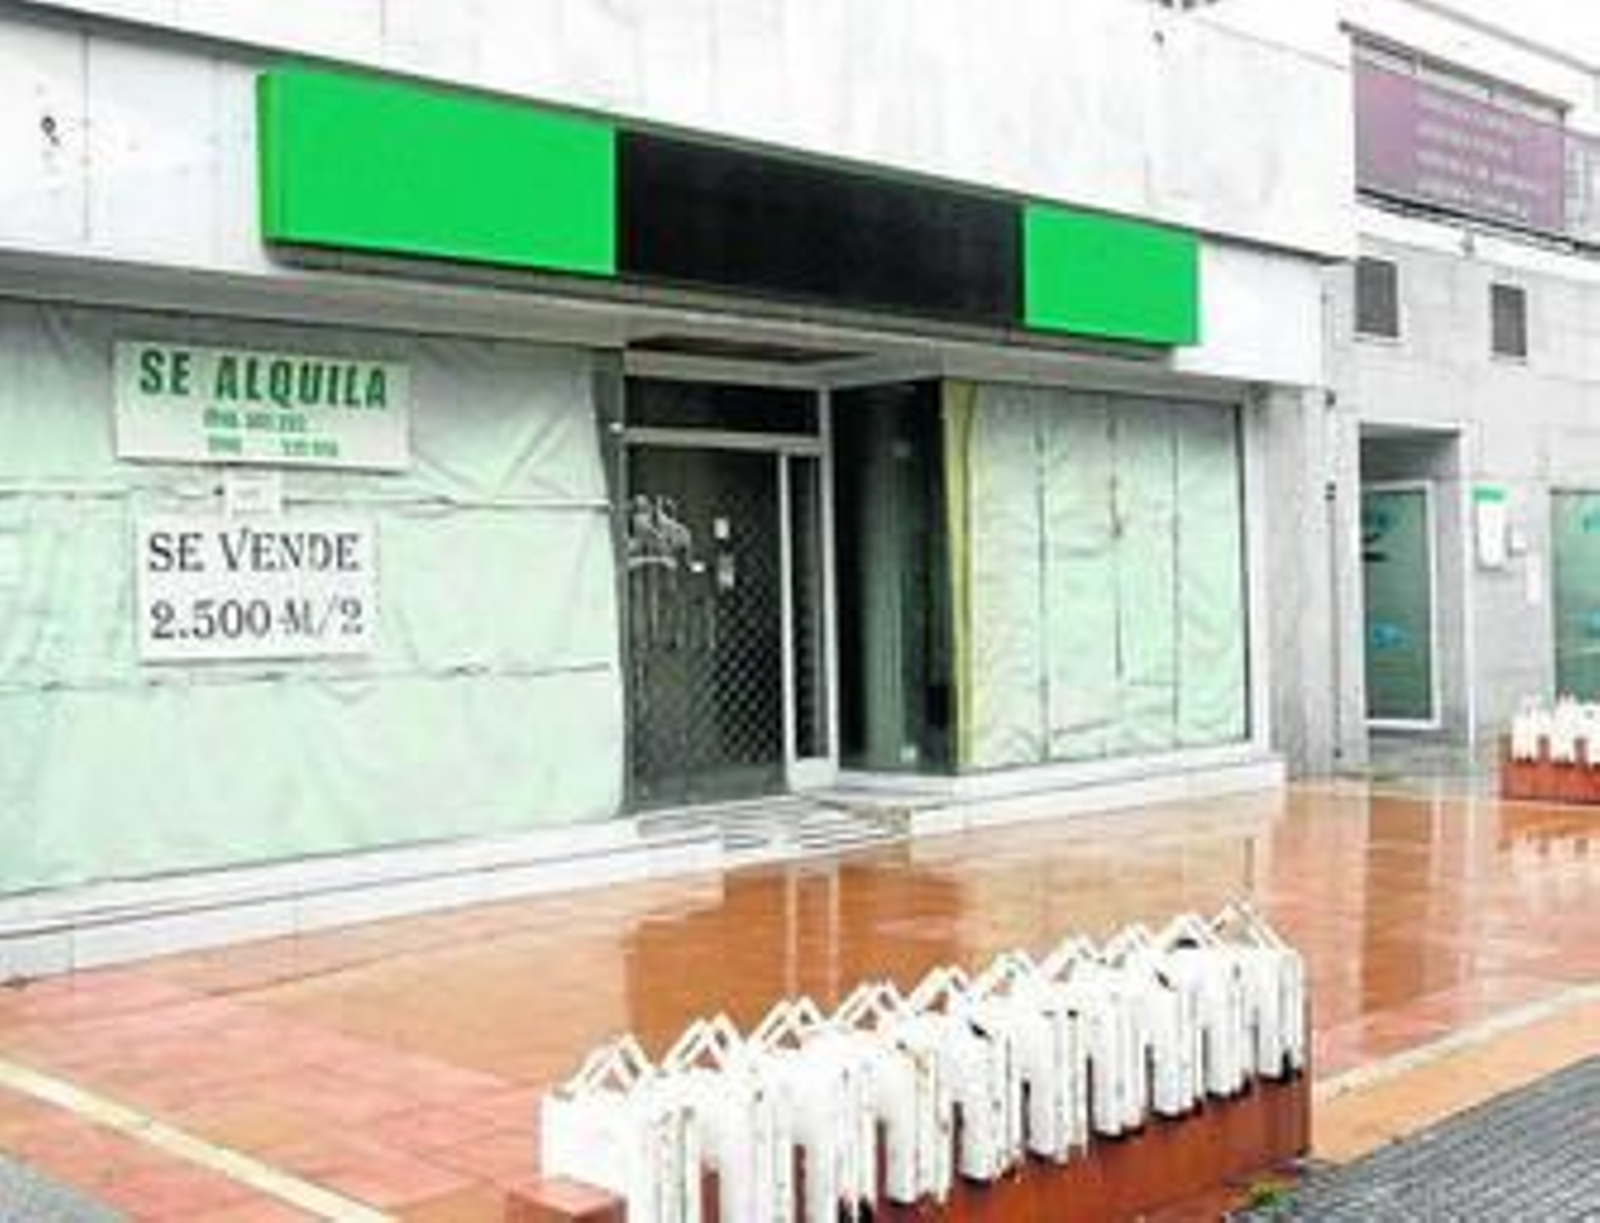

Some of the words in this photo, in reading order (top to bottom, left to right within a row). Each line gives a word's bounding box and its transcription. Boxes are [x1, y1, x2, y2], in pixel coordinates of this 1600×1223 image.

[140, 349, 190, 395] SE
[216, 355, 387, 408] ALQUILA
[149, 532, 204, 572] SE
[218, 527, 362, 572] VENDE
